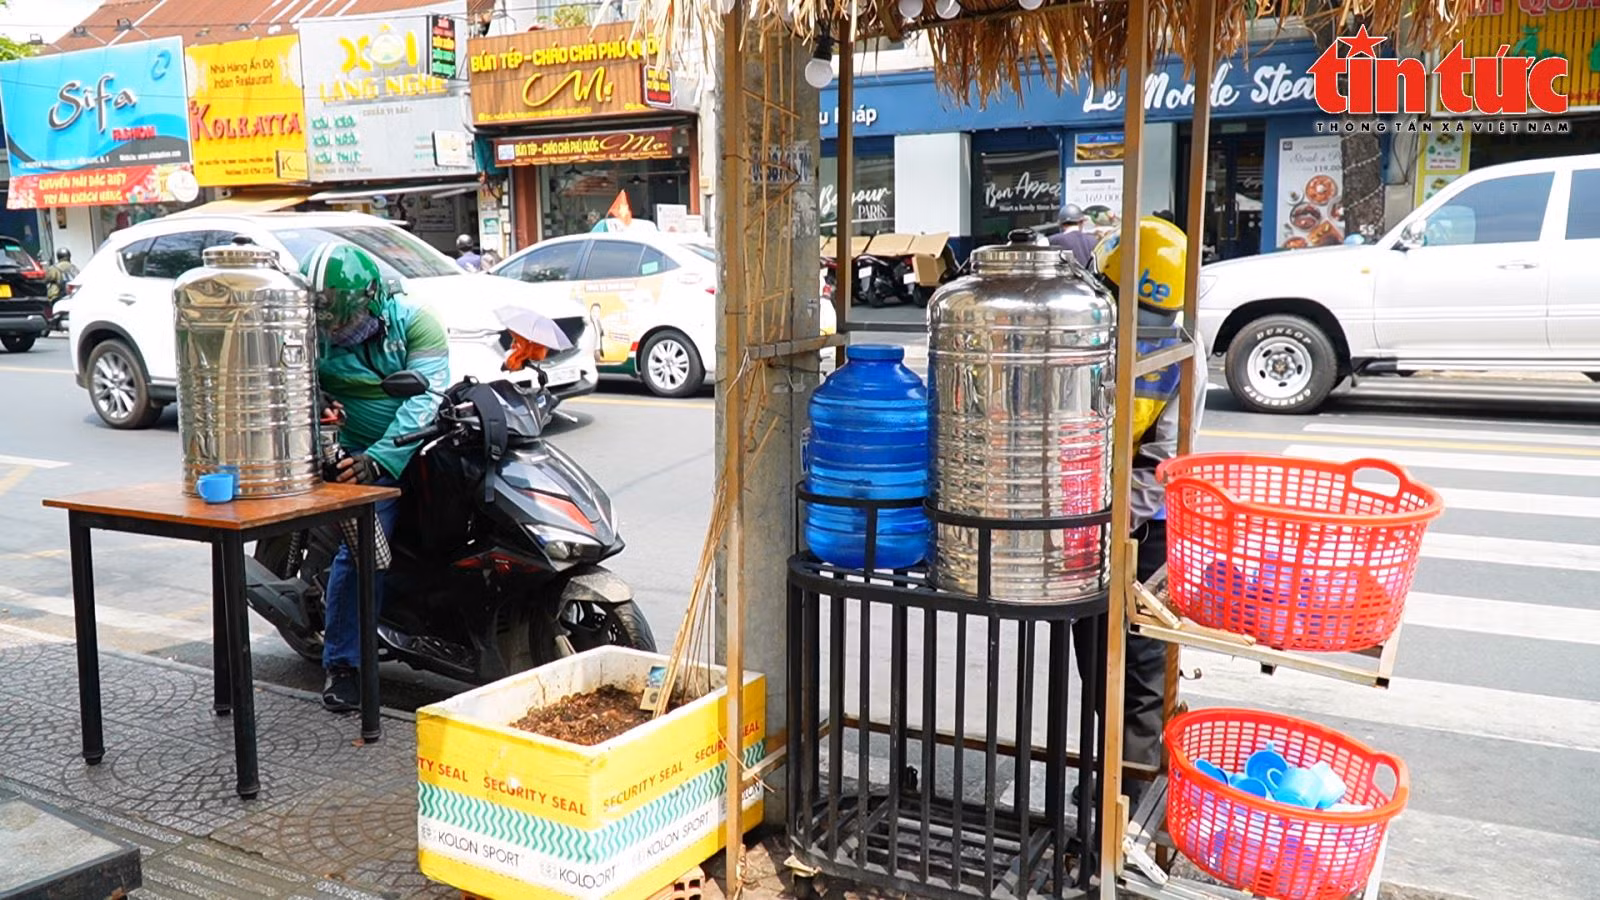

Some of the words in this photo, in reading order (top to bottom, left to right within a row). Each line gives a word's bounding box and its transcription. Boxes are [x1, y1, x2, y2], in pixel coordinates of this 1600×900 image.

[1250, 62, 1316, 106] Stea
[48, 75, 137, 135] Sifa
[819, 184, 892, 215] Boour
[858, 203, 888, 219] PARIS
[985, 183, 1013, 208] Bon
[1256, 327, 1312, 344] DUNLOP
[742, 720, 760, 738] EAL
[694, 737, 727, 764] SECUR
[438, 763, 469, 783] SEAL
[603, 773, 656, 808] SECURITY
[659, 761, 684, 782] SEAL
[483, 775, 547, 805] SECURITY
[552, 796, 587, 817] SEAL
[438, 830, 478, 855] KOLON
[482, 844, 520, 867] SPORT
[646, 831, 680, 858] KOLON
[682, 812, 710, 838] SPORT
